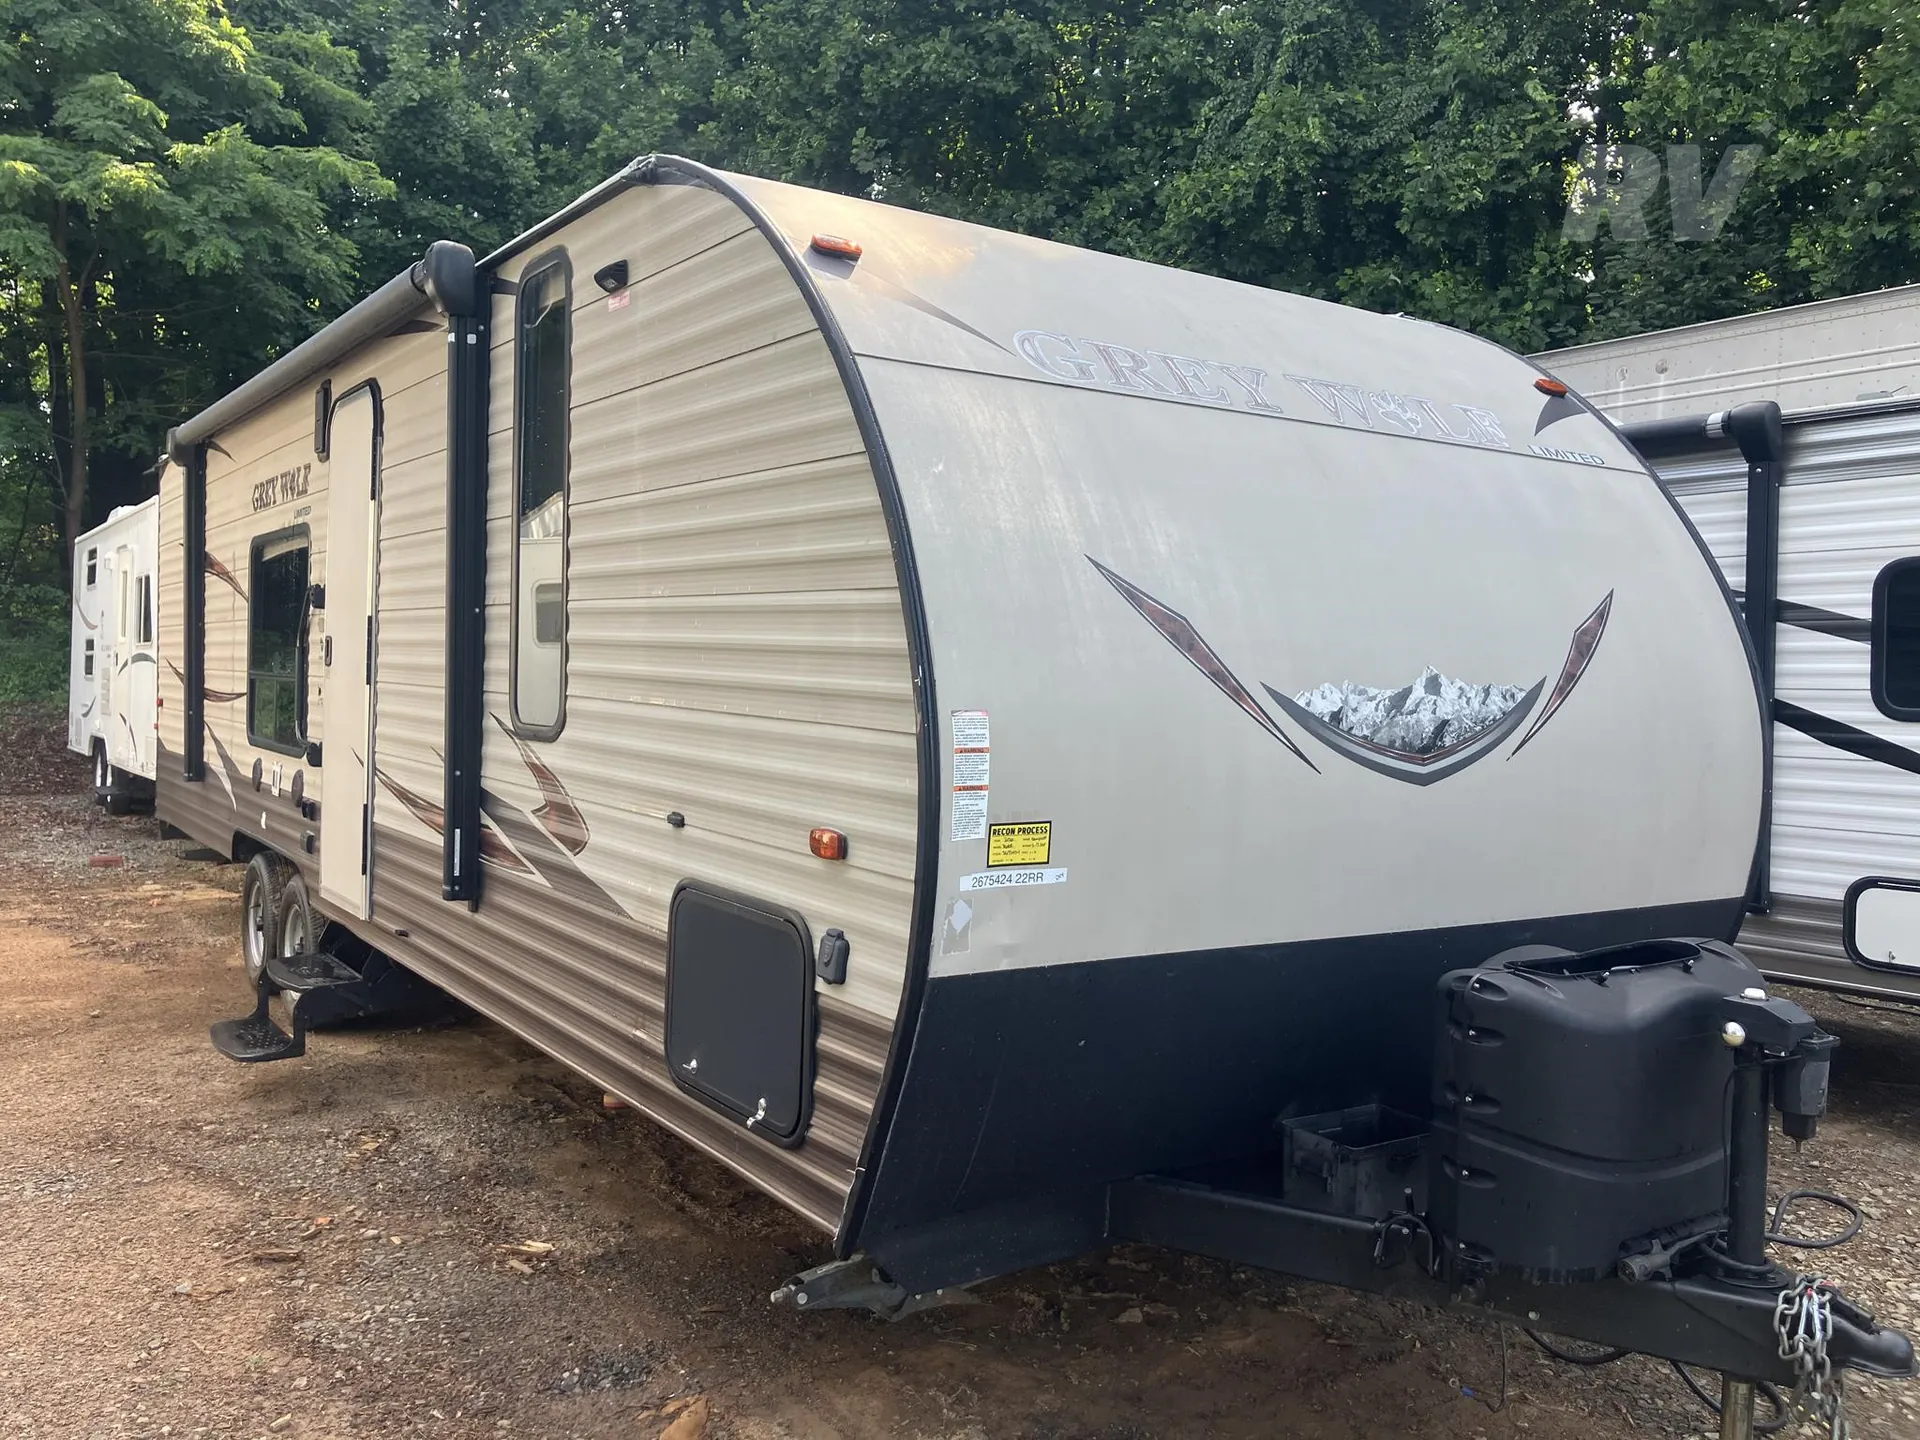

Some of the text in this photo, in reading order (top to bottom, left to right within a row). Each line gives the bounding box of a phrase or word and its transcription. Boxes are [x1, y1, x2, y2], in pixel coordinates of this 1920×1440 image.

[1014, 329, 1283, 413] GREY
[1527, 444, 1605, 466] LIMITED
[252, 475, 278, 512] GREY
[992, 825, 1048, 836] RECON PROCESS
[972, 873, 1013, 888] 2675424
[1015, 872, 1044, 884] 22RR
